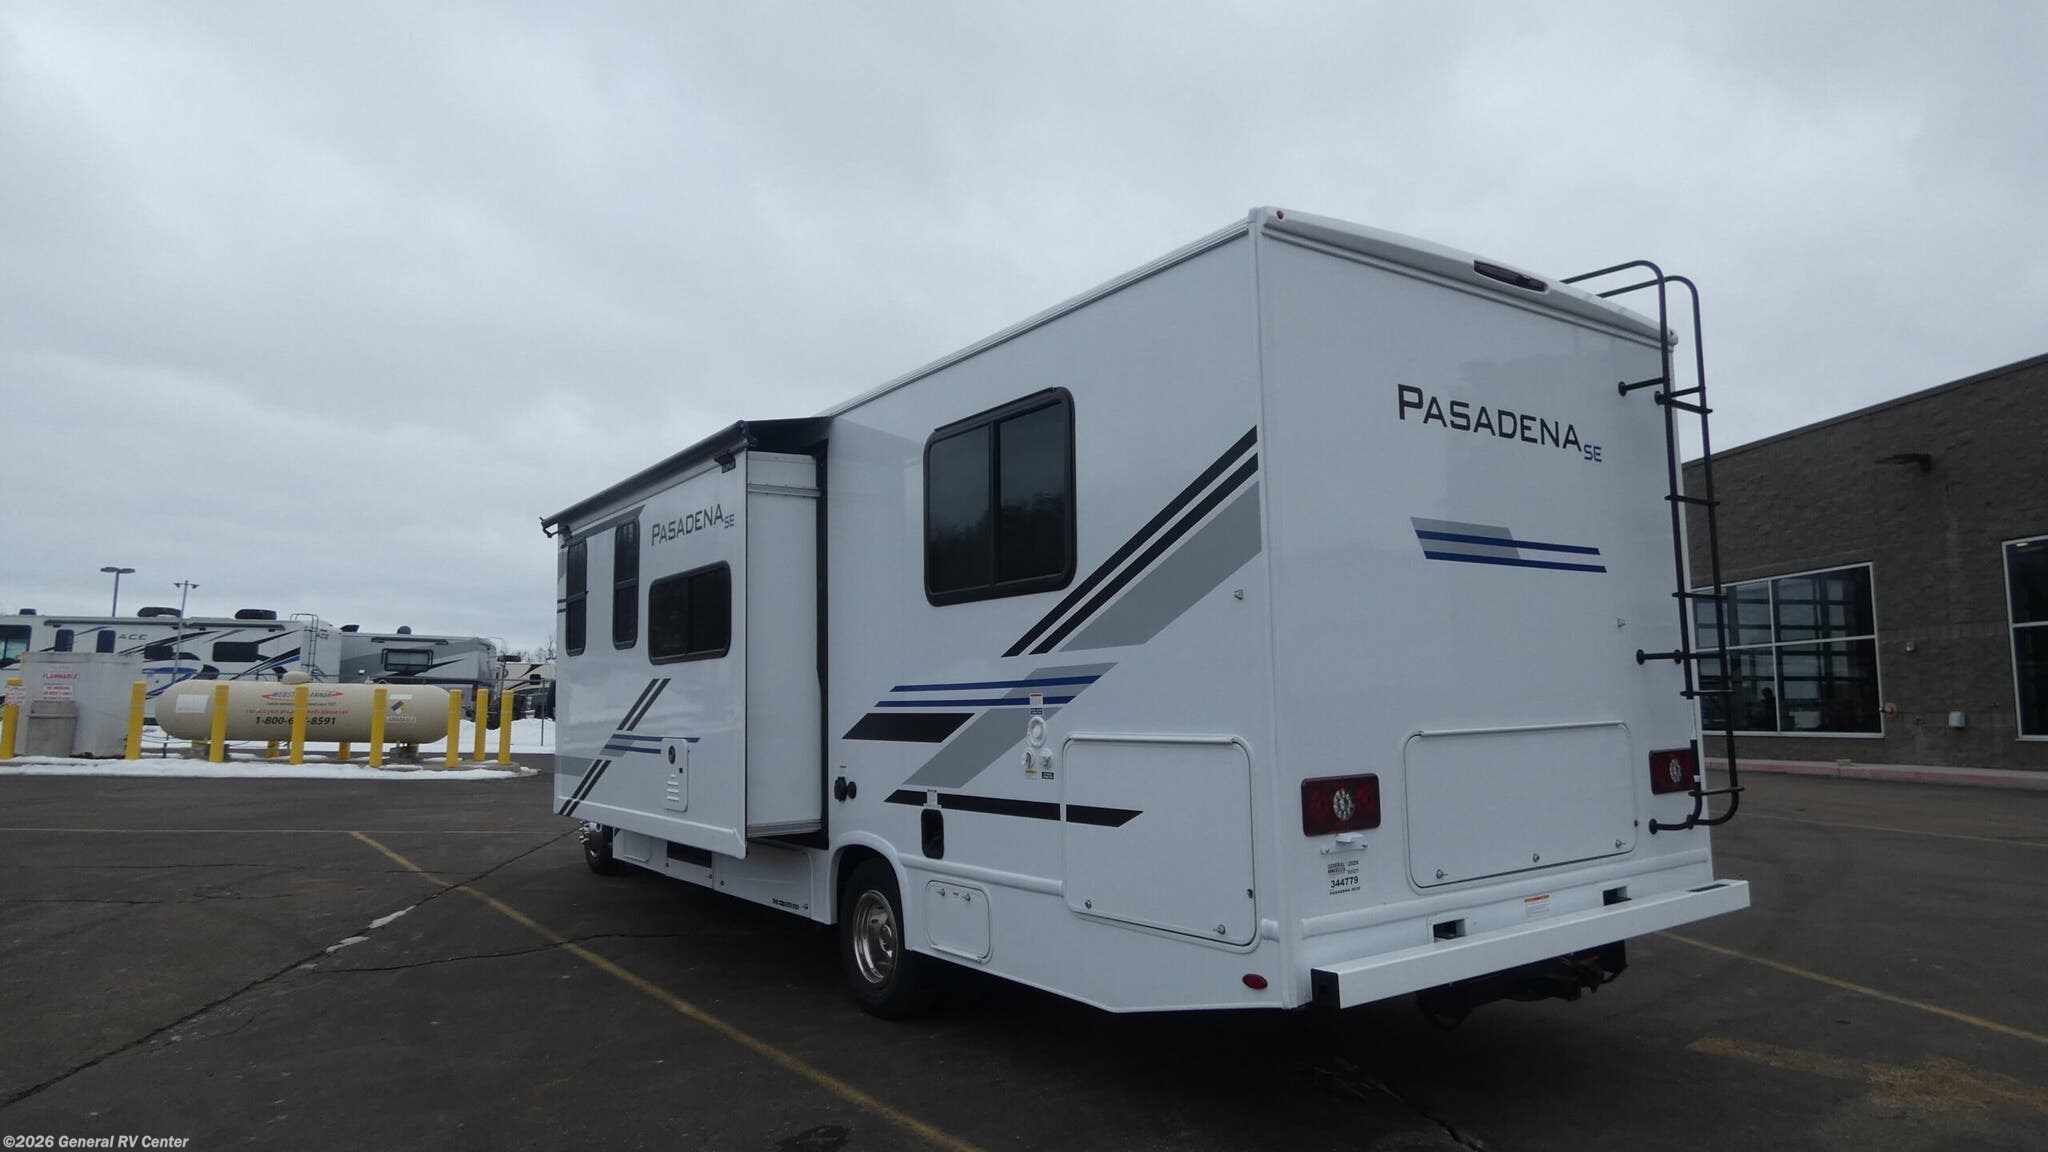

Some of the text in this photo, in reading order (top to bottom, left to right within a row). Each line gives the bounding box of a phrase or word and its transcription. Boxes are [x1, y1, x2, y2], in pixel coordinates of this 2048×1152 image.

[1397, 383, 1603, 463] PASADENA SE
[651, 503, 735, 547] PASADENA SE
[255, 716, 336, 726] 1-800-6-8591
[1331, 876, 1358, 888] 344779
